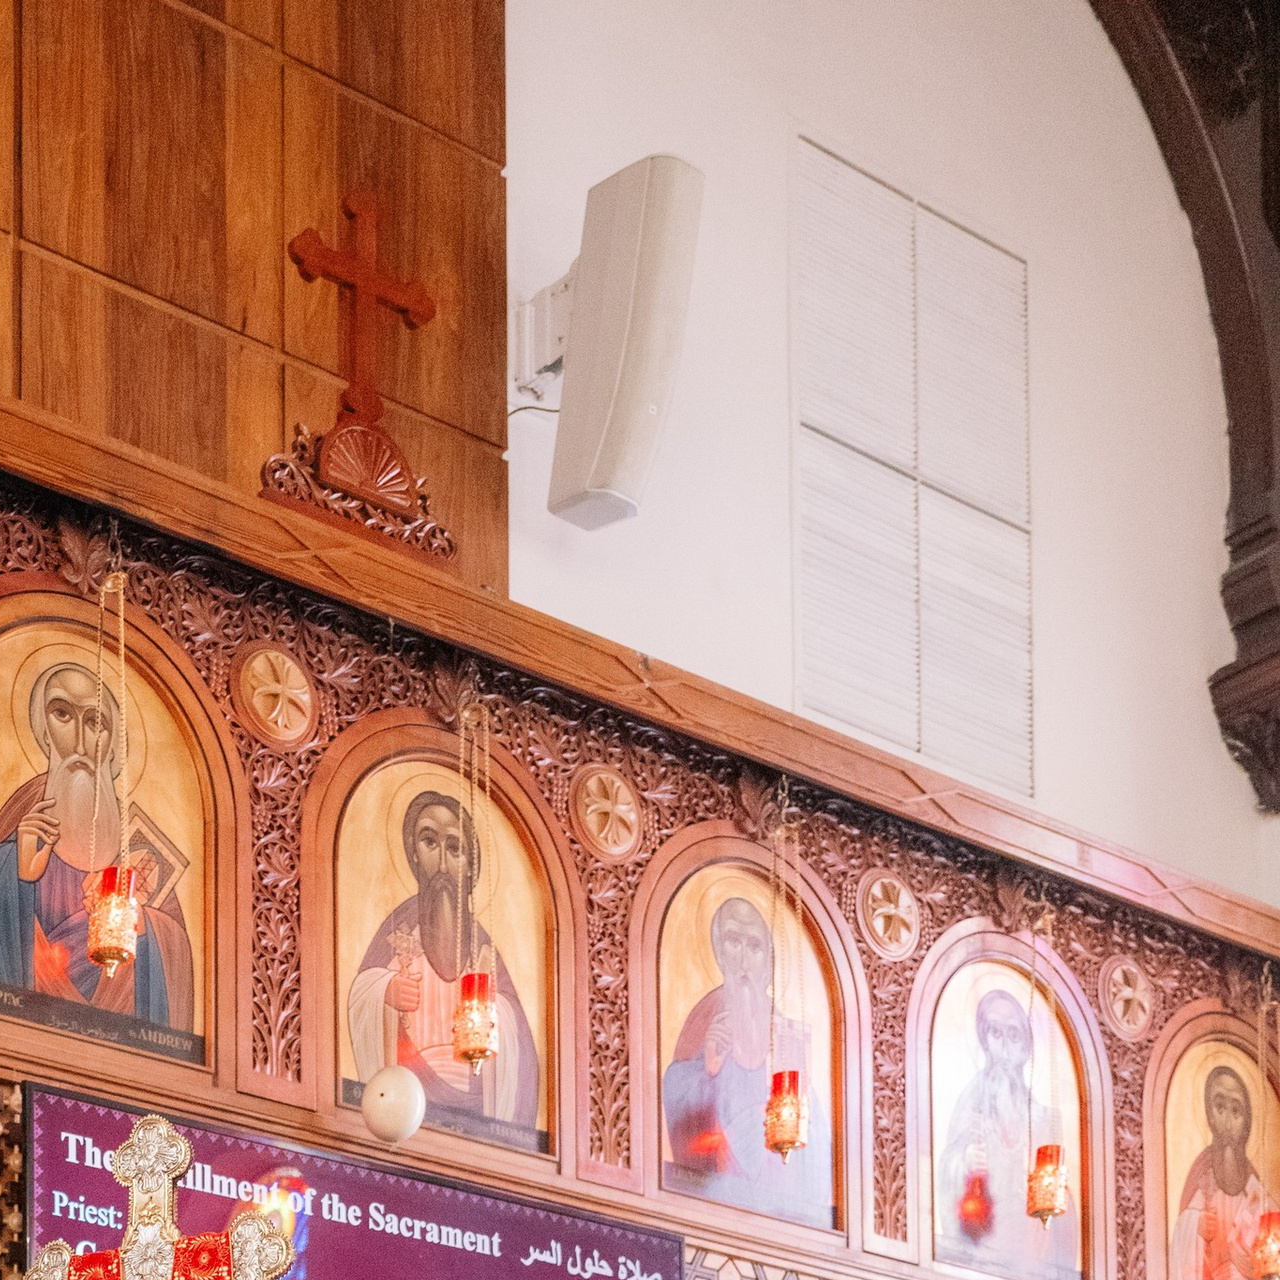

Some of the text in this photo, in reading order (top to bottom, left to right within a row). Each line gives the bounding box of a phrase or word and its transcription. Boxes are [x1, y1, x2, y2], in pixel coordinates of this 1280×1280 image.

[137, 1028, 193, 1051] ANDREW
[51, 1190, 124, 1230] Priest:
[60, 1131, 116, 1172] The
[286, 1187, 317, 1217] of
[321, 1192, 362, 1227] the
[368, 1202, 503, 1258] Sacrament
[520, 1239, 562, 1267] السر
[566, 1244, 614, 1279] حلول
